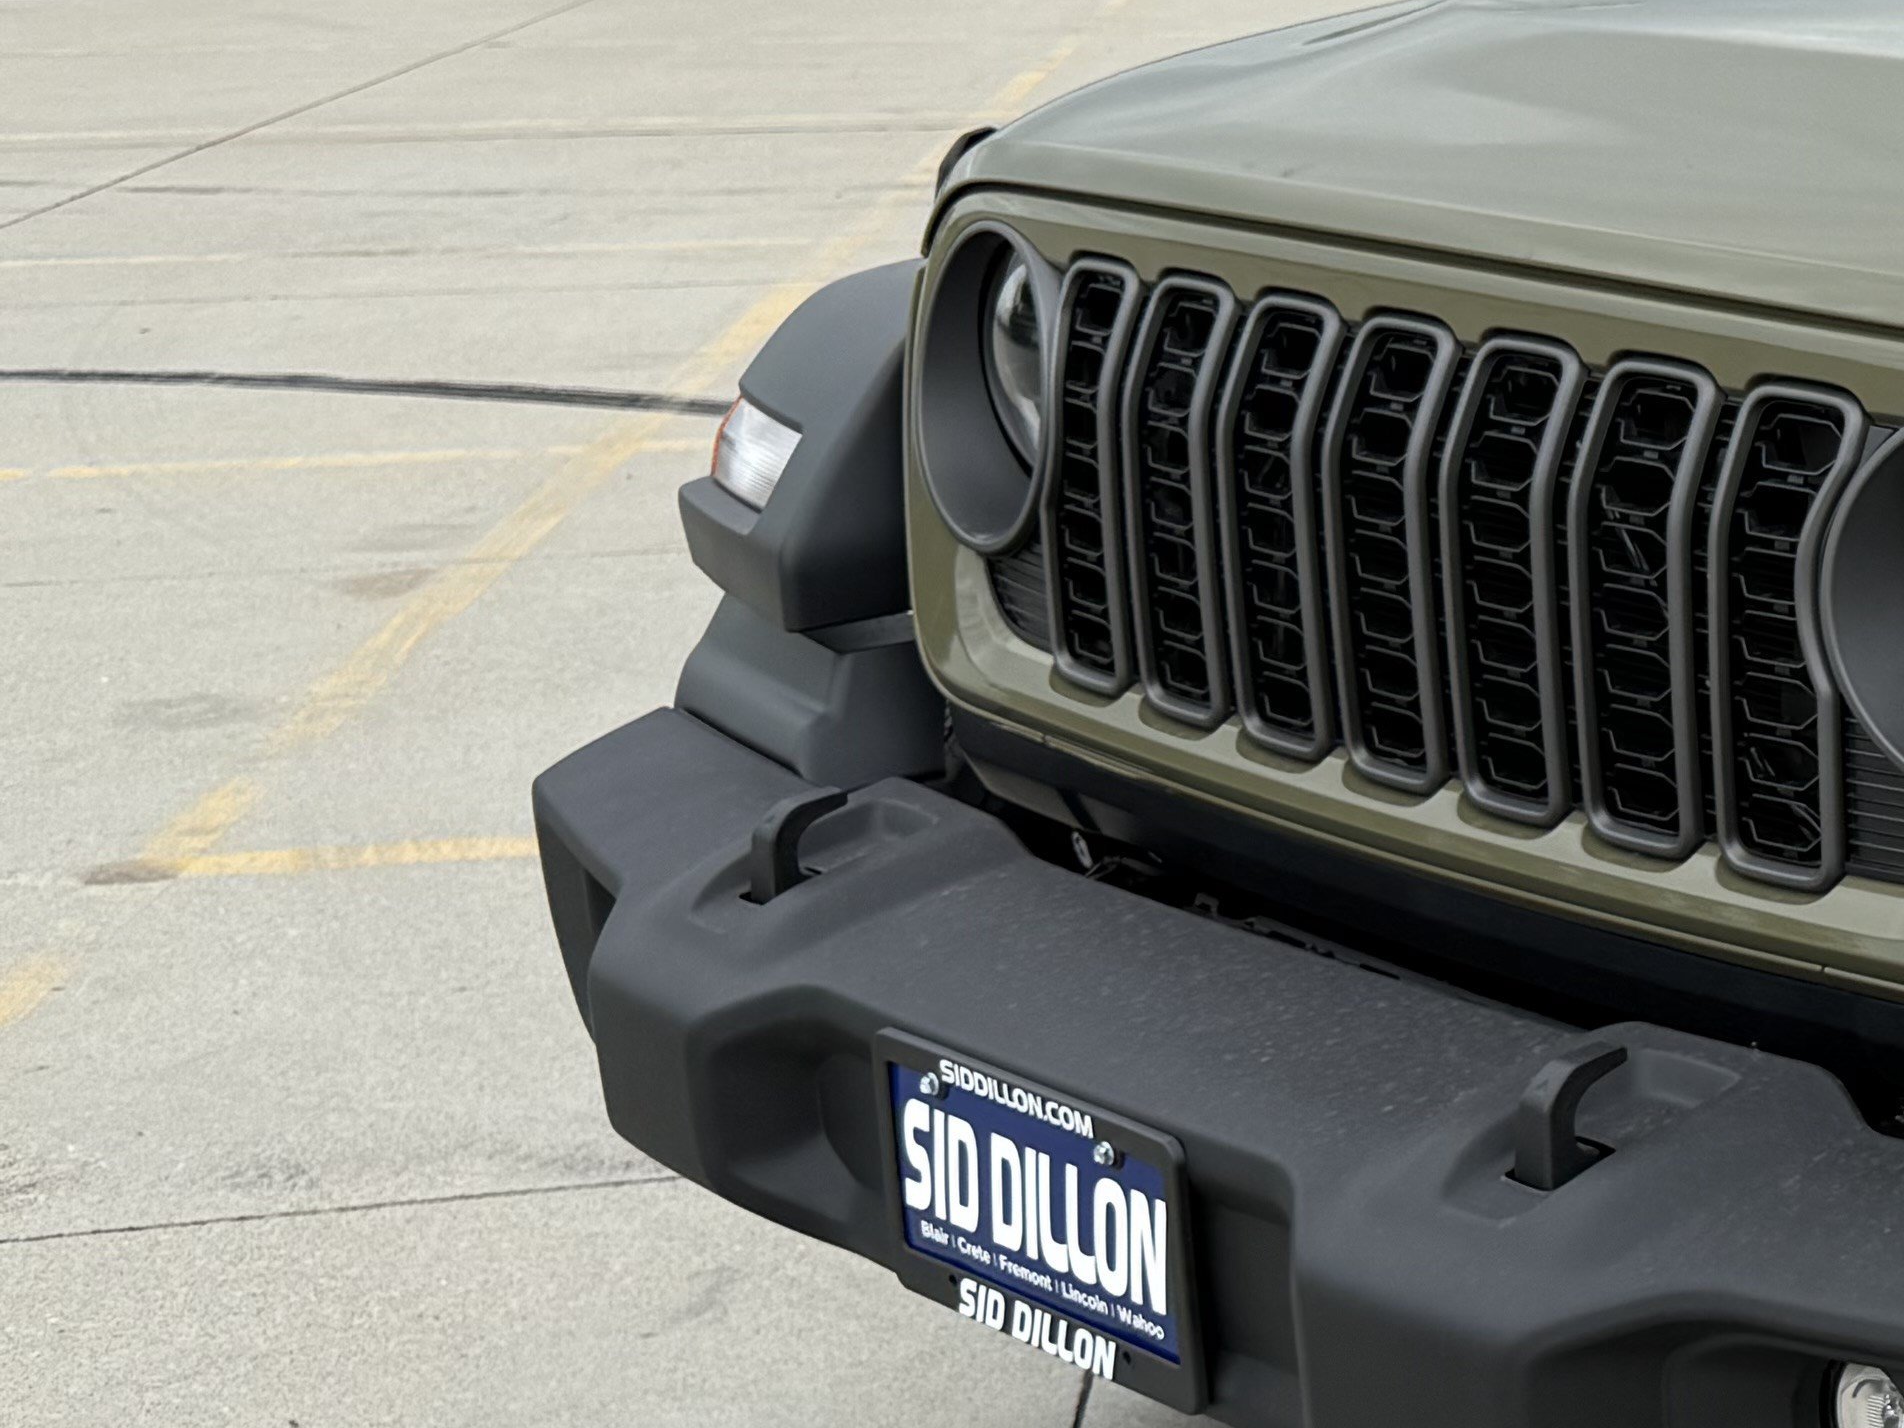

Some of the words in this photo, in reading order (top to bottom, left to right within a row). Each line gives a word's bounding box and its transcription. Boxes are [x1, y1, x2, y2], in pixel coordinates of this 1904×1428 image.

[939, 1059, 1094, 1139] SIDDILLON.COM
[903, 1098, 980, 1234] SID
[990, 1132, 1168, 1316] DILLON
[920, 1220, 949, 1246] Blair
[957, 1237, 991, 1266] Crete
[999, 1255, 1053, 1292] Fremont
[1061, 1281, 1109, 1316] Lincoln
[1116, 1304, 1165, 1341] Wahoo
[958, 1278, 1006, 1332] SID
[1012, 1299, 1118, 1381] DILLON
